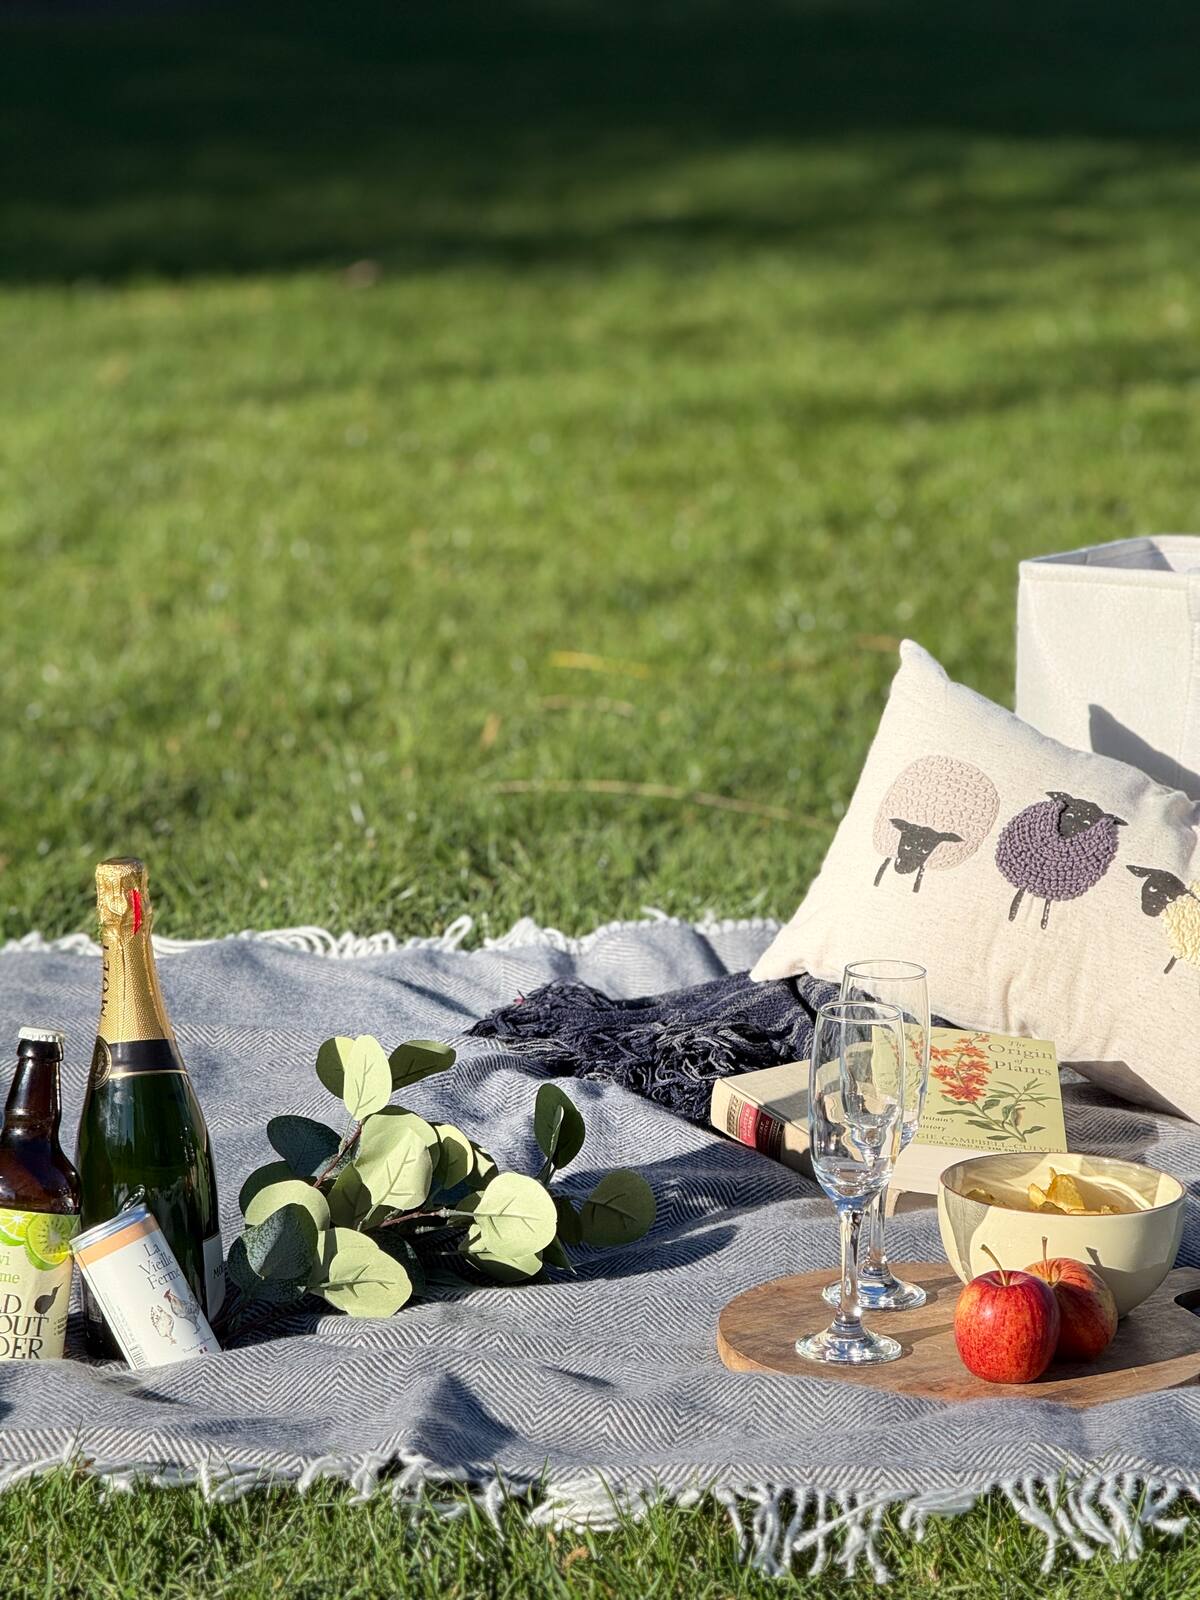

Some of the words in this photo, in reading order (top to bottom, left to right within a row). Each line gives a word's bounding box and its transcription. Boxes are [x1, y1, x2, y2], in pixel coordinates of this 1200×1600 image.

[988, 1043, 1053, 1060] Origin
[994, 1060, 1052, 1076] Plants
[143, 1243, 161, 1257] La
[138, 1251, 174, 1275] Vieille
[146, 1268, 181, 1290] Ferme
